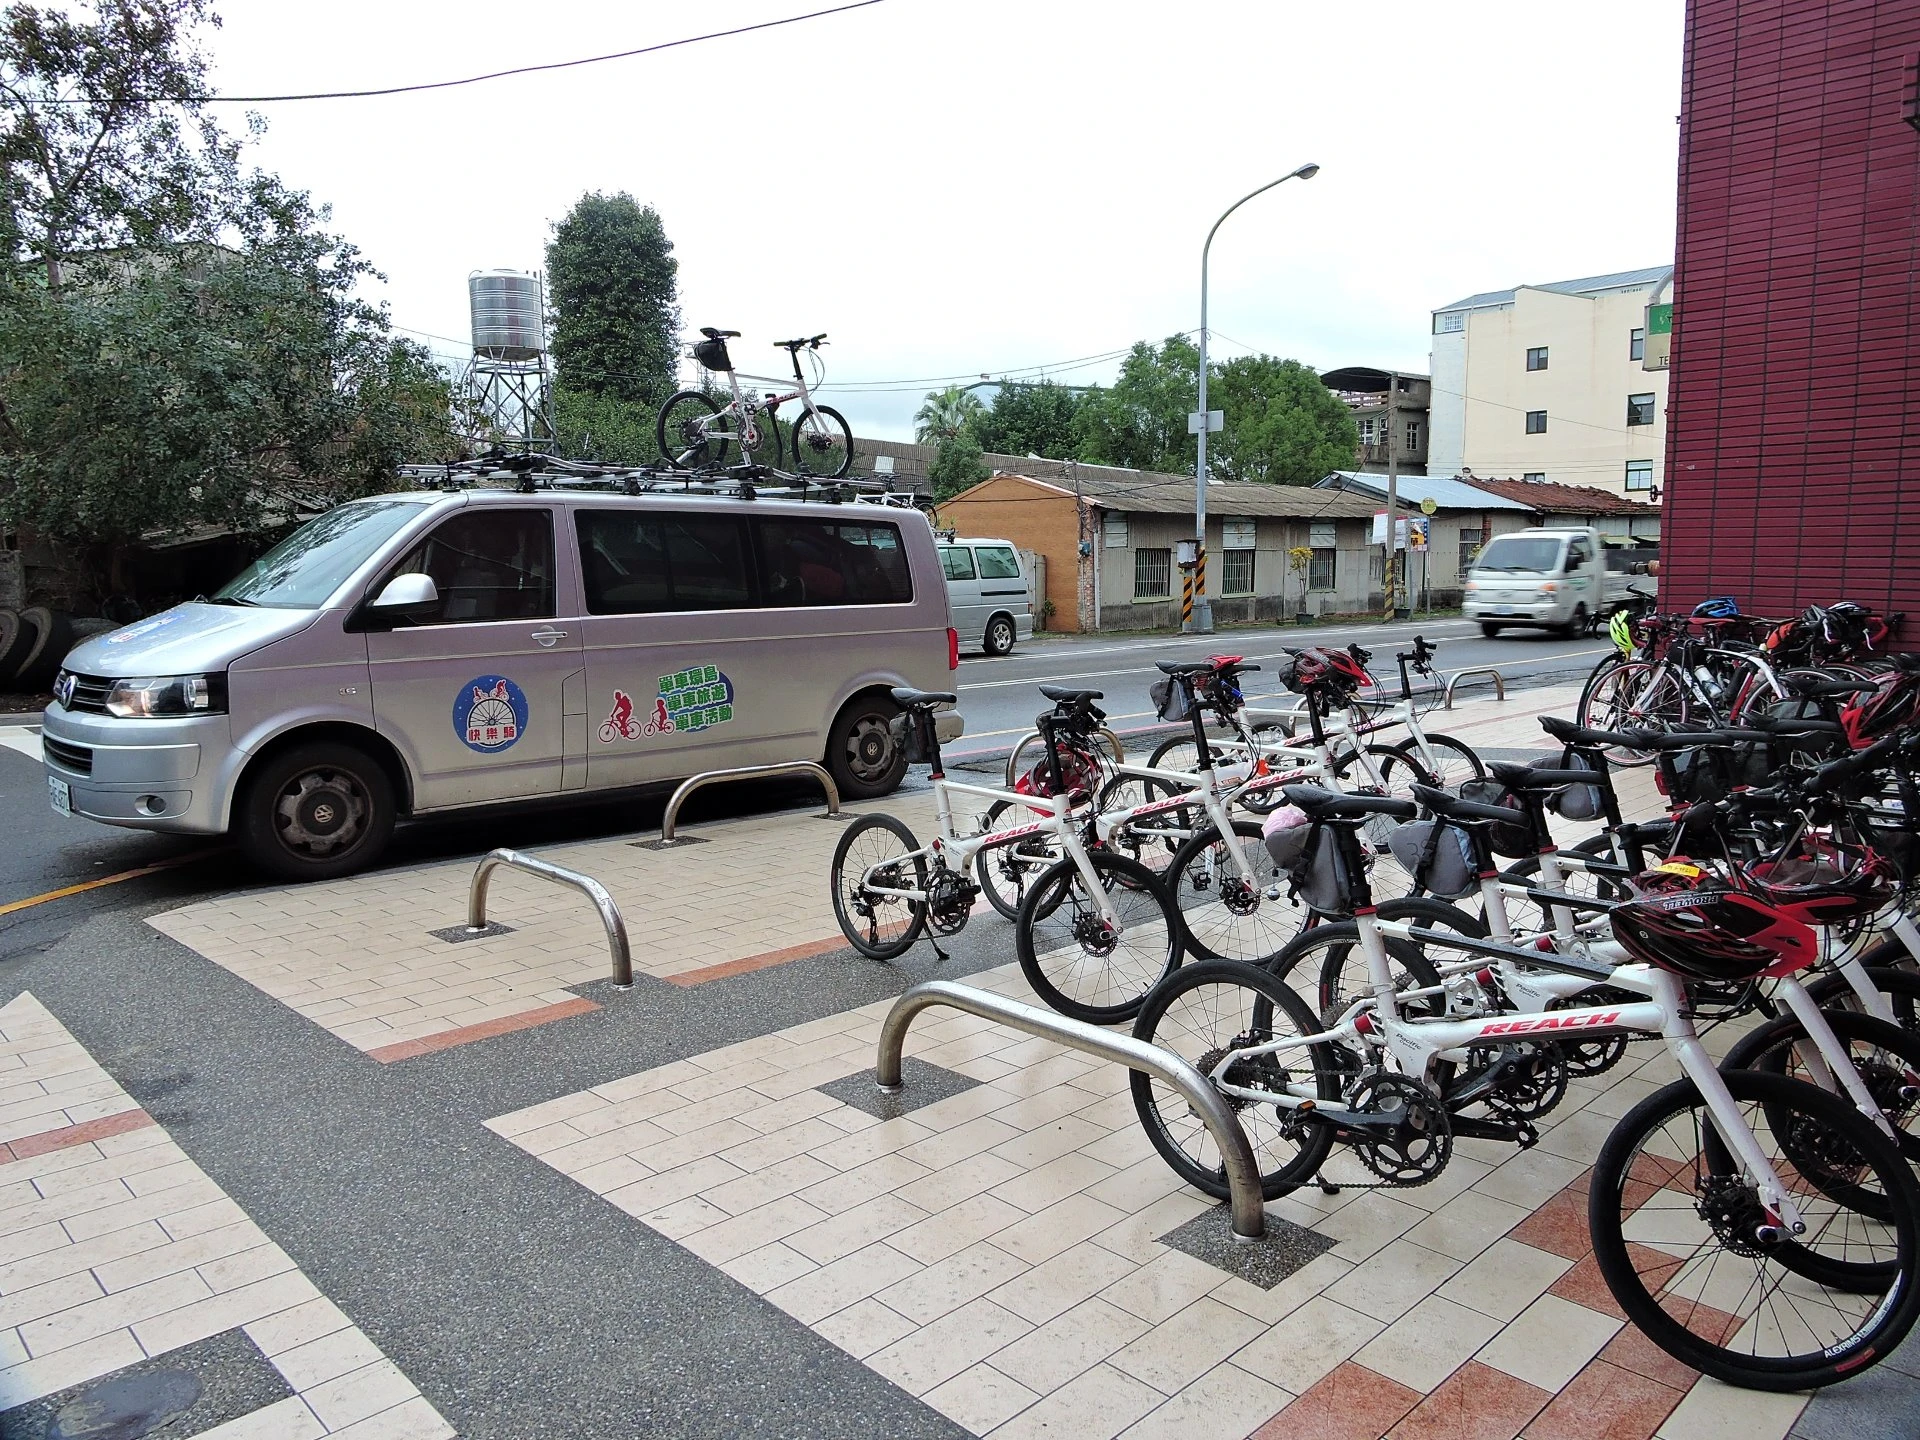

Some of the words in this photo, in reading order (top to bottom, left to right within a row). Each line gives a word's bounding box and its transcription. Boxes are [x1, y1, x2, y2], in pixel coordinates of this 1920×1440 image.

[659, 665, 718, 693] 單車環島
[675, 704, 732, 730] 單車活動
[468, 726, 515, 741] 快樂騎
[1248, 769, 1303, 788] REACH
[1131, 796, 1187, 815] REACH
[984, 822, 1041, 843] REACH
[1663, 895, 1718, 911] PROWELL
[1516, 983, 1541, 998] Pacific
[1480, 1012, 1620, 1035] REACH
[1396, 1033, 1421, 1050] Pacific
[1824, 1333, 1862, 1359] ALEXRIMS
